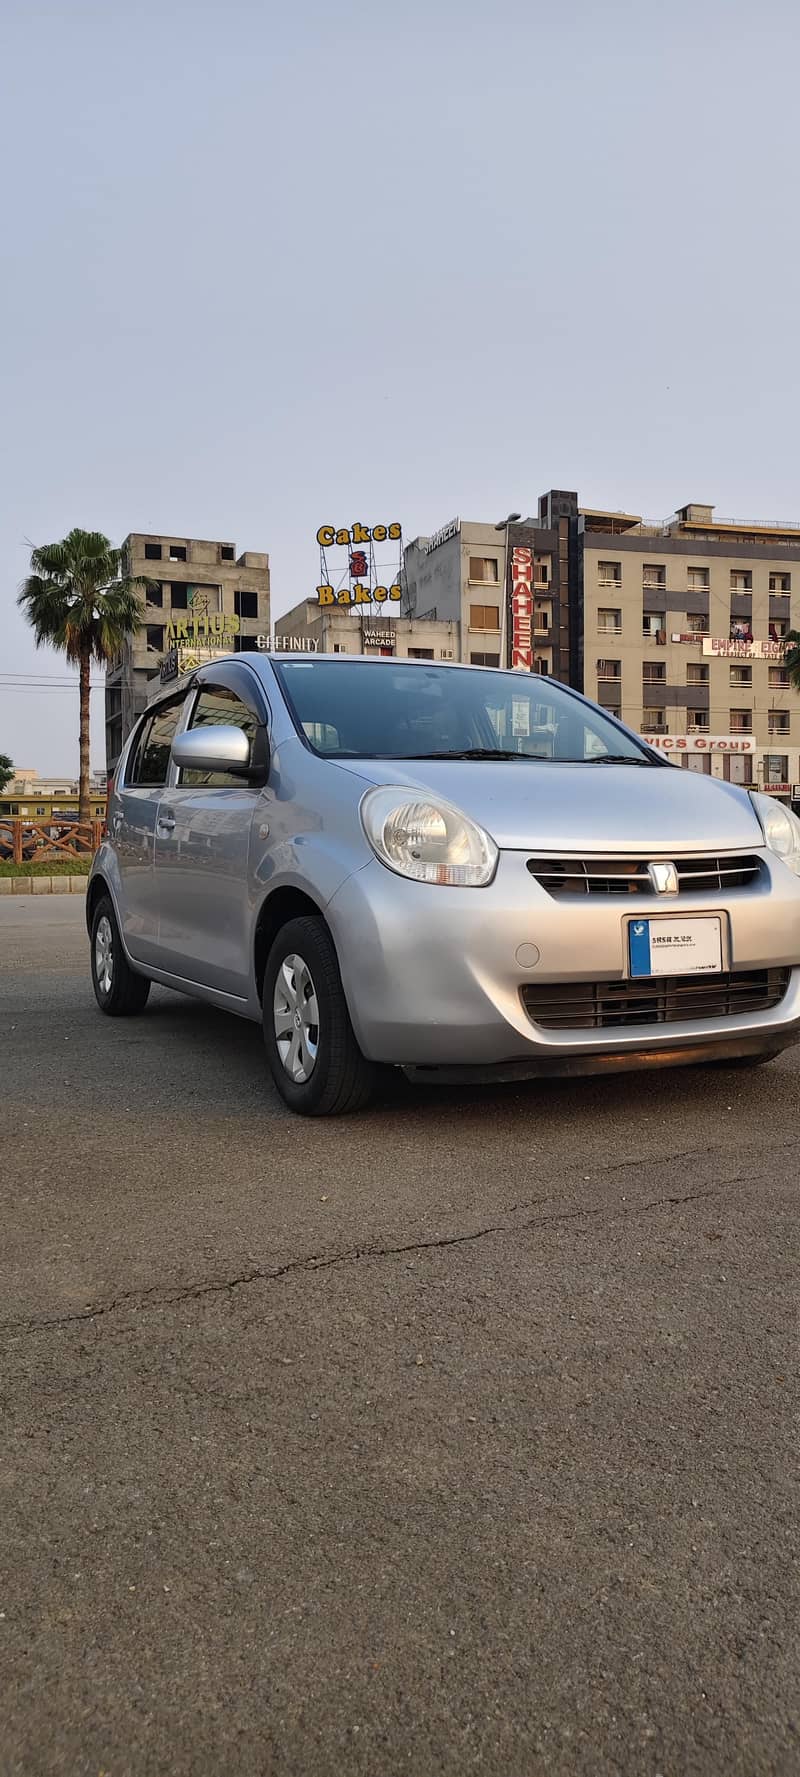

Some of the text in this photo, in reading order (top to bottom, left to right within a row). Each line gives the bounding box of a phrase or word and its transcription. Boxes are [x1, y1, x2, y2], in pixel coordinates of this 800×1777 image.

[317, 522, 402, 546] Cakes
[317, 584, 402, 606] Bakes
[512, 547, 534, 667] SHAHEEN
[165, 613, 241, 639] ARTIUS
[363, 630, 396, 639] WAHEED
[364, 638, 396, 647] ARCADE
[694, 738, 751, 751] Group
